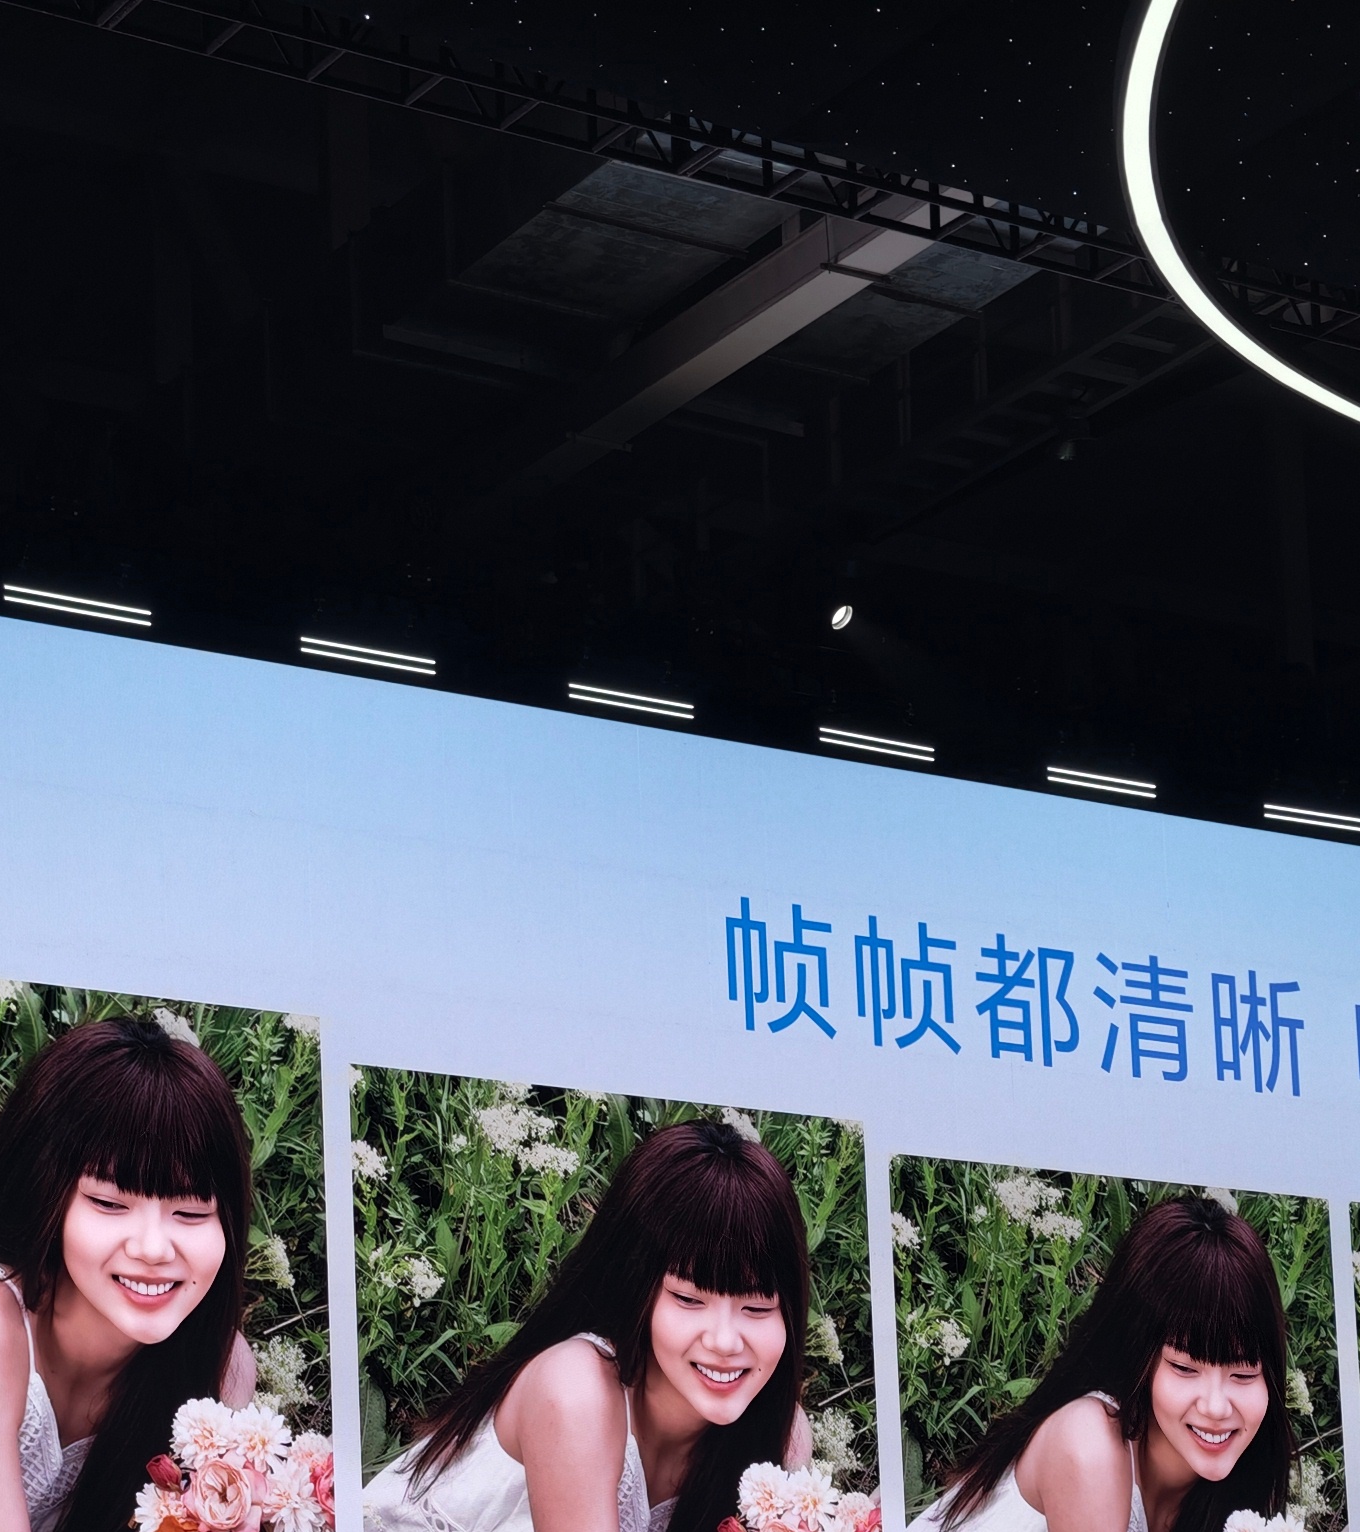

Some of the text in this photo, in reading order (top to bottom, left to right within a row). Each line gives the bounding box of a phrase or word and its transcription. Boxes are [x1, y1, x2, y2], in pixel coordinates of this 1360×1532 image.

[725, 896, 1305, 1098] 帧帧都清晰
